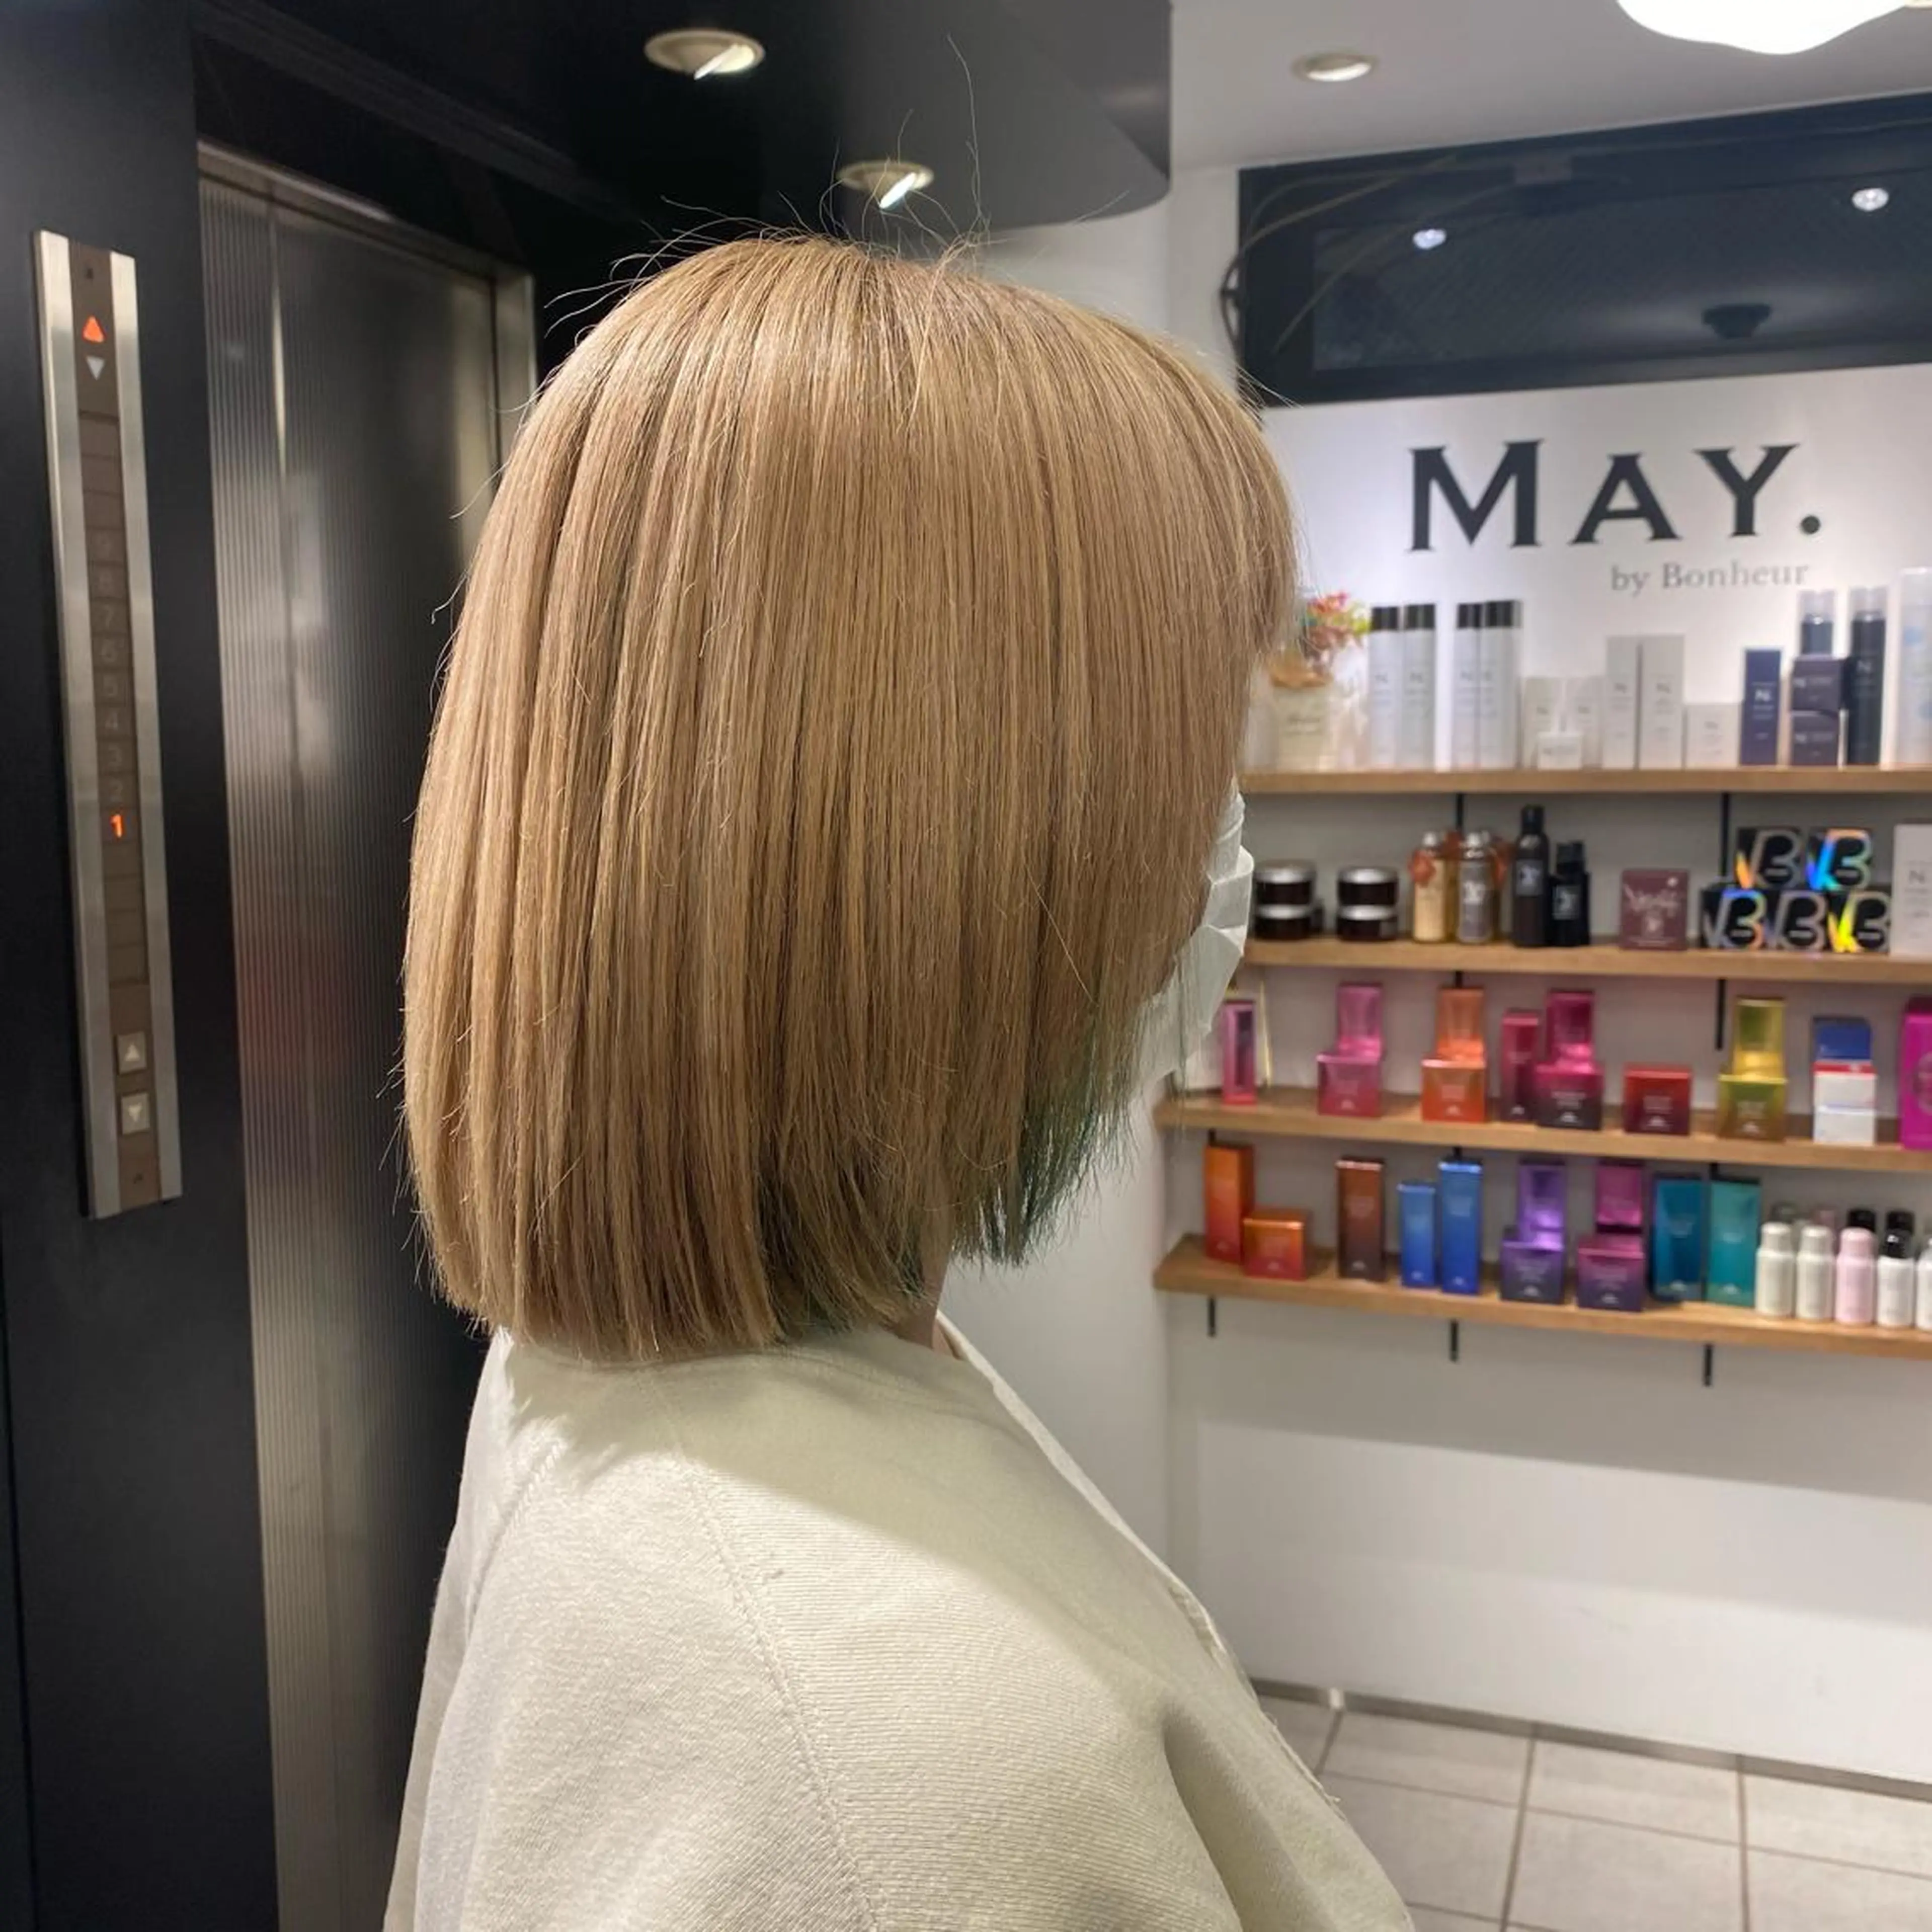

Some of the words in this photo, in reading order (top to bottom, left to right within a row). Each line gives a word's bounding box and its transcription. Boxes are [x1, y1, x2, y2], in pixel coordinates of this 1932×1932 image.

[1412, 440, 1820, 550] MAY.
[1610, 563, 1651, 598] by
[1662, 558, 1810, 589] Bonheur
[101, 604, 115, 629] 7
[108, 744, 122, 767] 3
[109, 779, 124, 802] 2
[110, 814, 122, 838] 1
